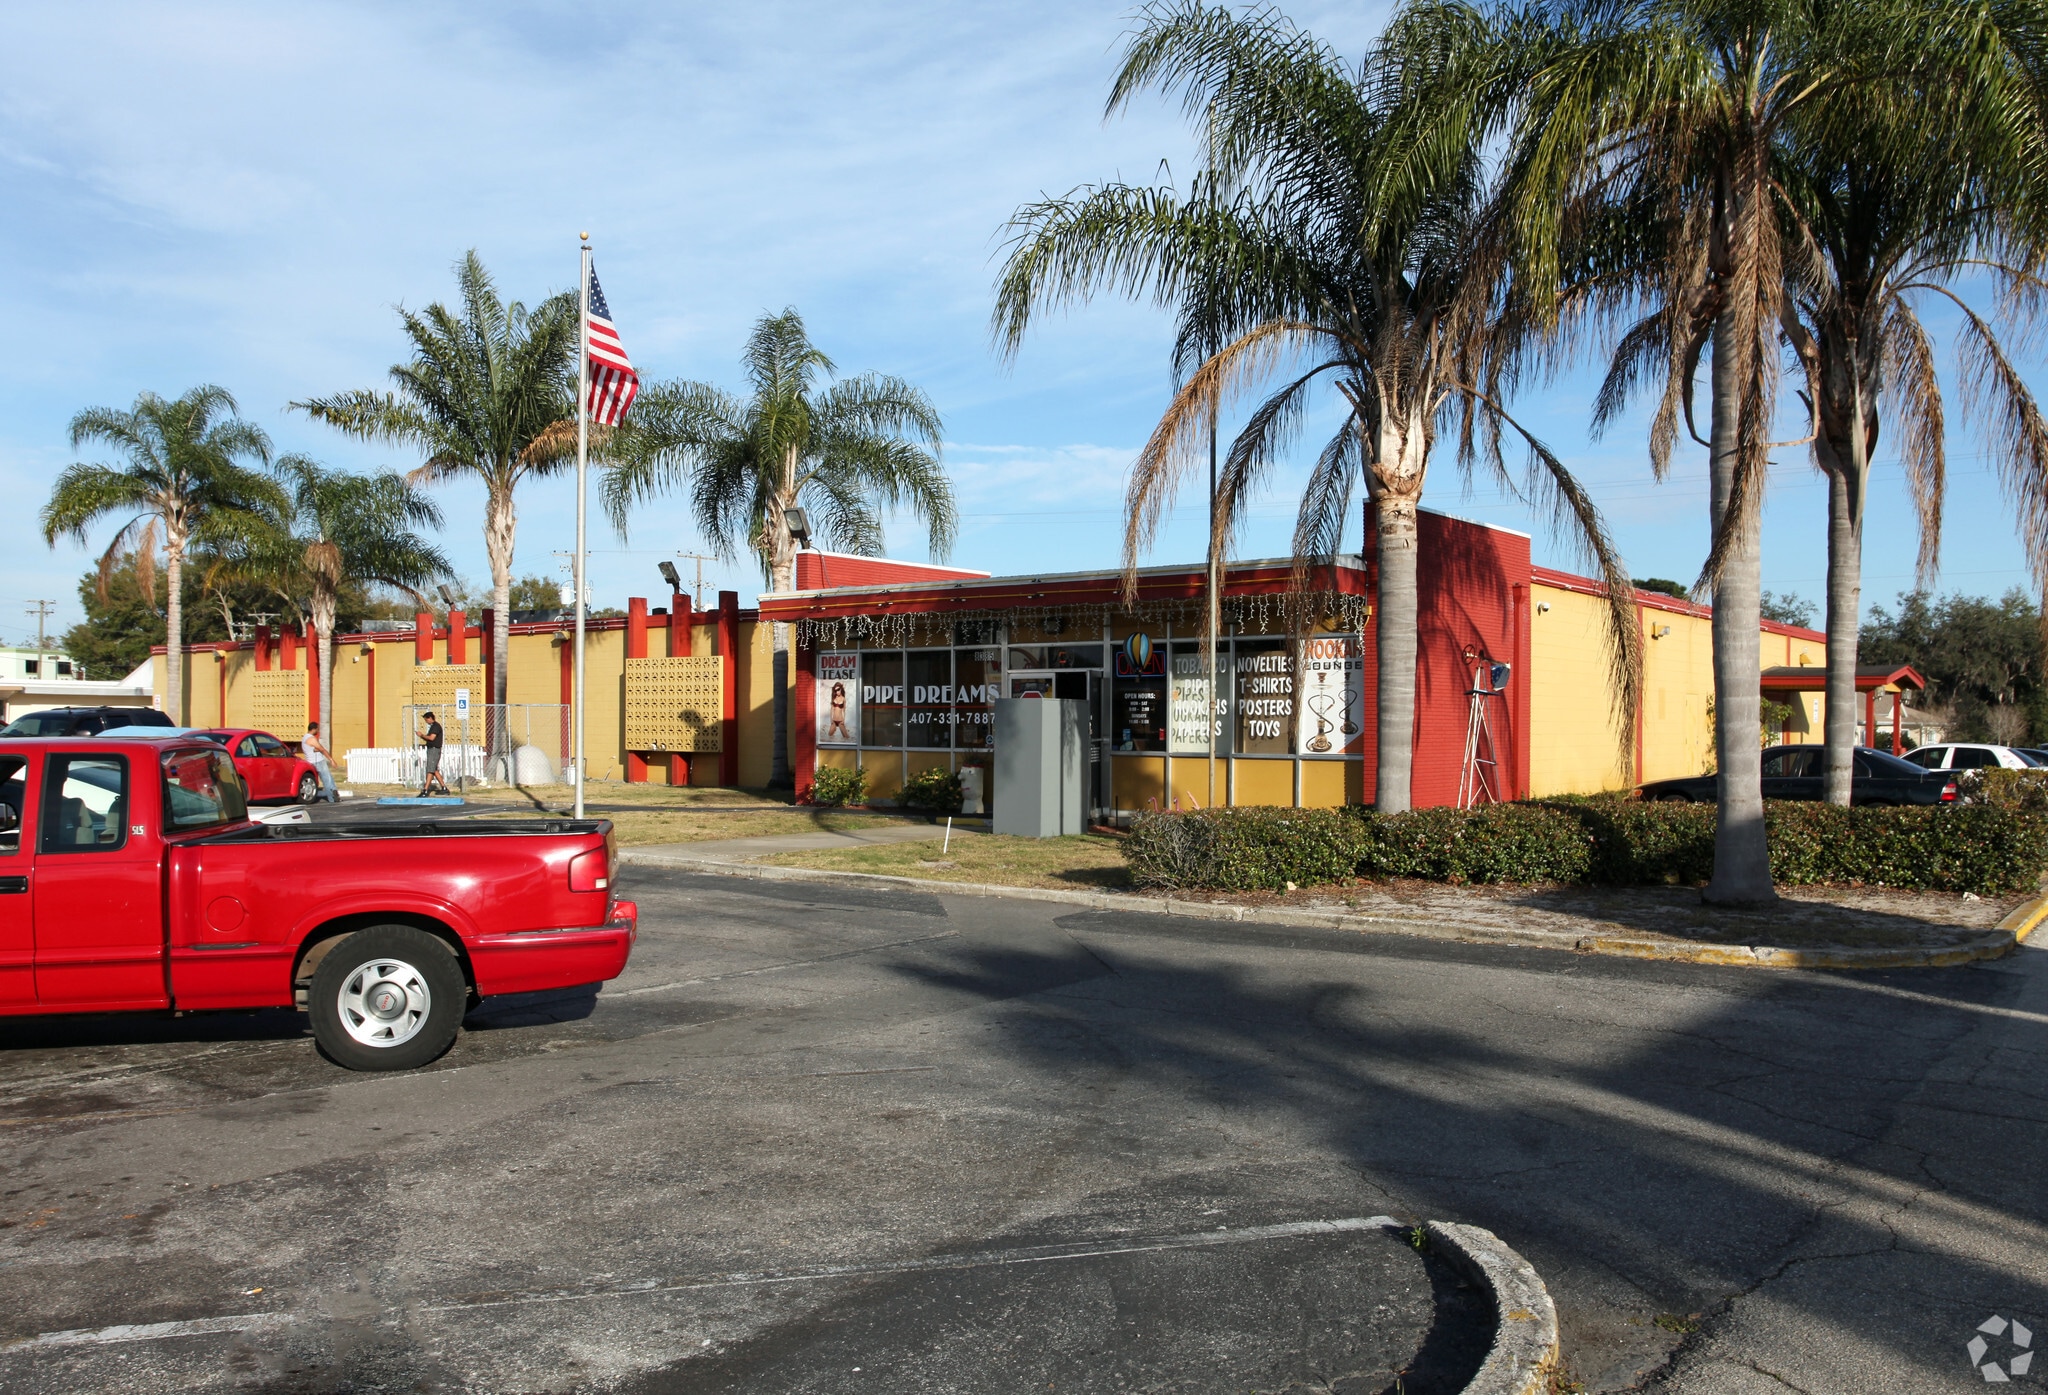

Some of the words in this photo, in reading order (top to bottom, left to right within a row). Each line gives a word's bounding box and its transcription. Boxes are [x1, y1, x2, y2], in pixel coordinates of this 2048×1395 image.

[1305, 639, 1362, 659] HOOKAH
[821, 655, 857, 669] DREAM
[1118, 653, 1165, 675] ON
[1176, 657, 1227, 674] TOBAO
[1237, 656, 1294, 673] NOVELTIES
[821, 669, 856, 680] TEASE
[863, 685, 904, 704] PIPE
[914, 684, 1000, 704] DREAMS
[1184, 679, 1217, 695] PIPE
[1239, 677, 1293, 694] T-SHIRTS
[1239, 699, 1293, 716] POSTERS
[910, 712, 996, 725] 407-331-7887
[1249, 720, 1280, 737] TOYS
